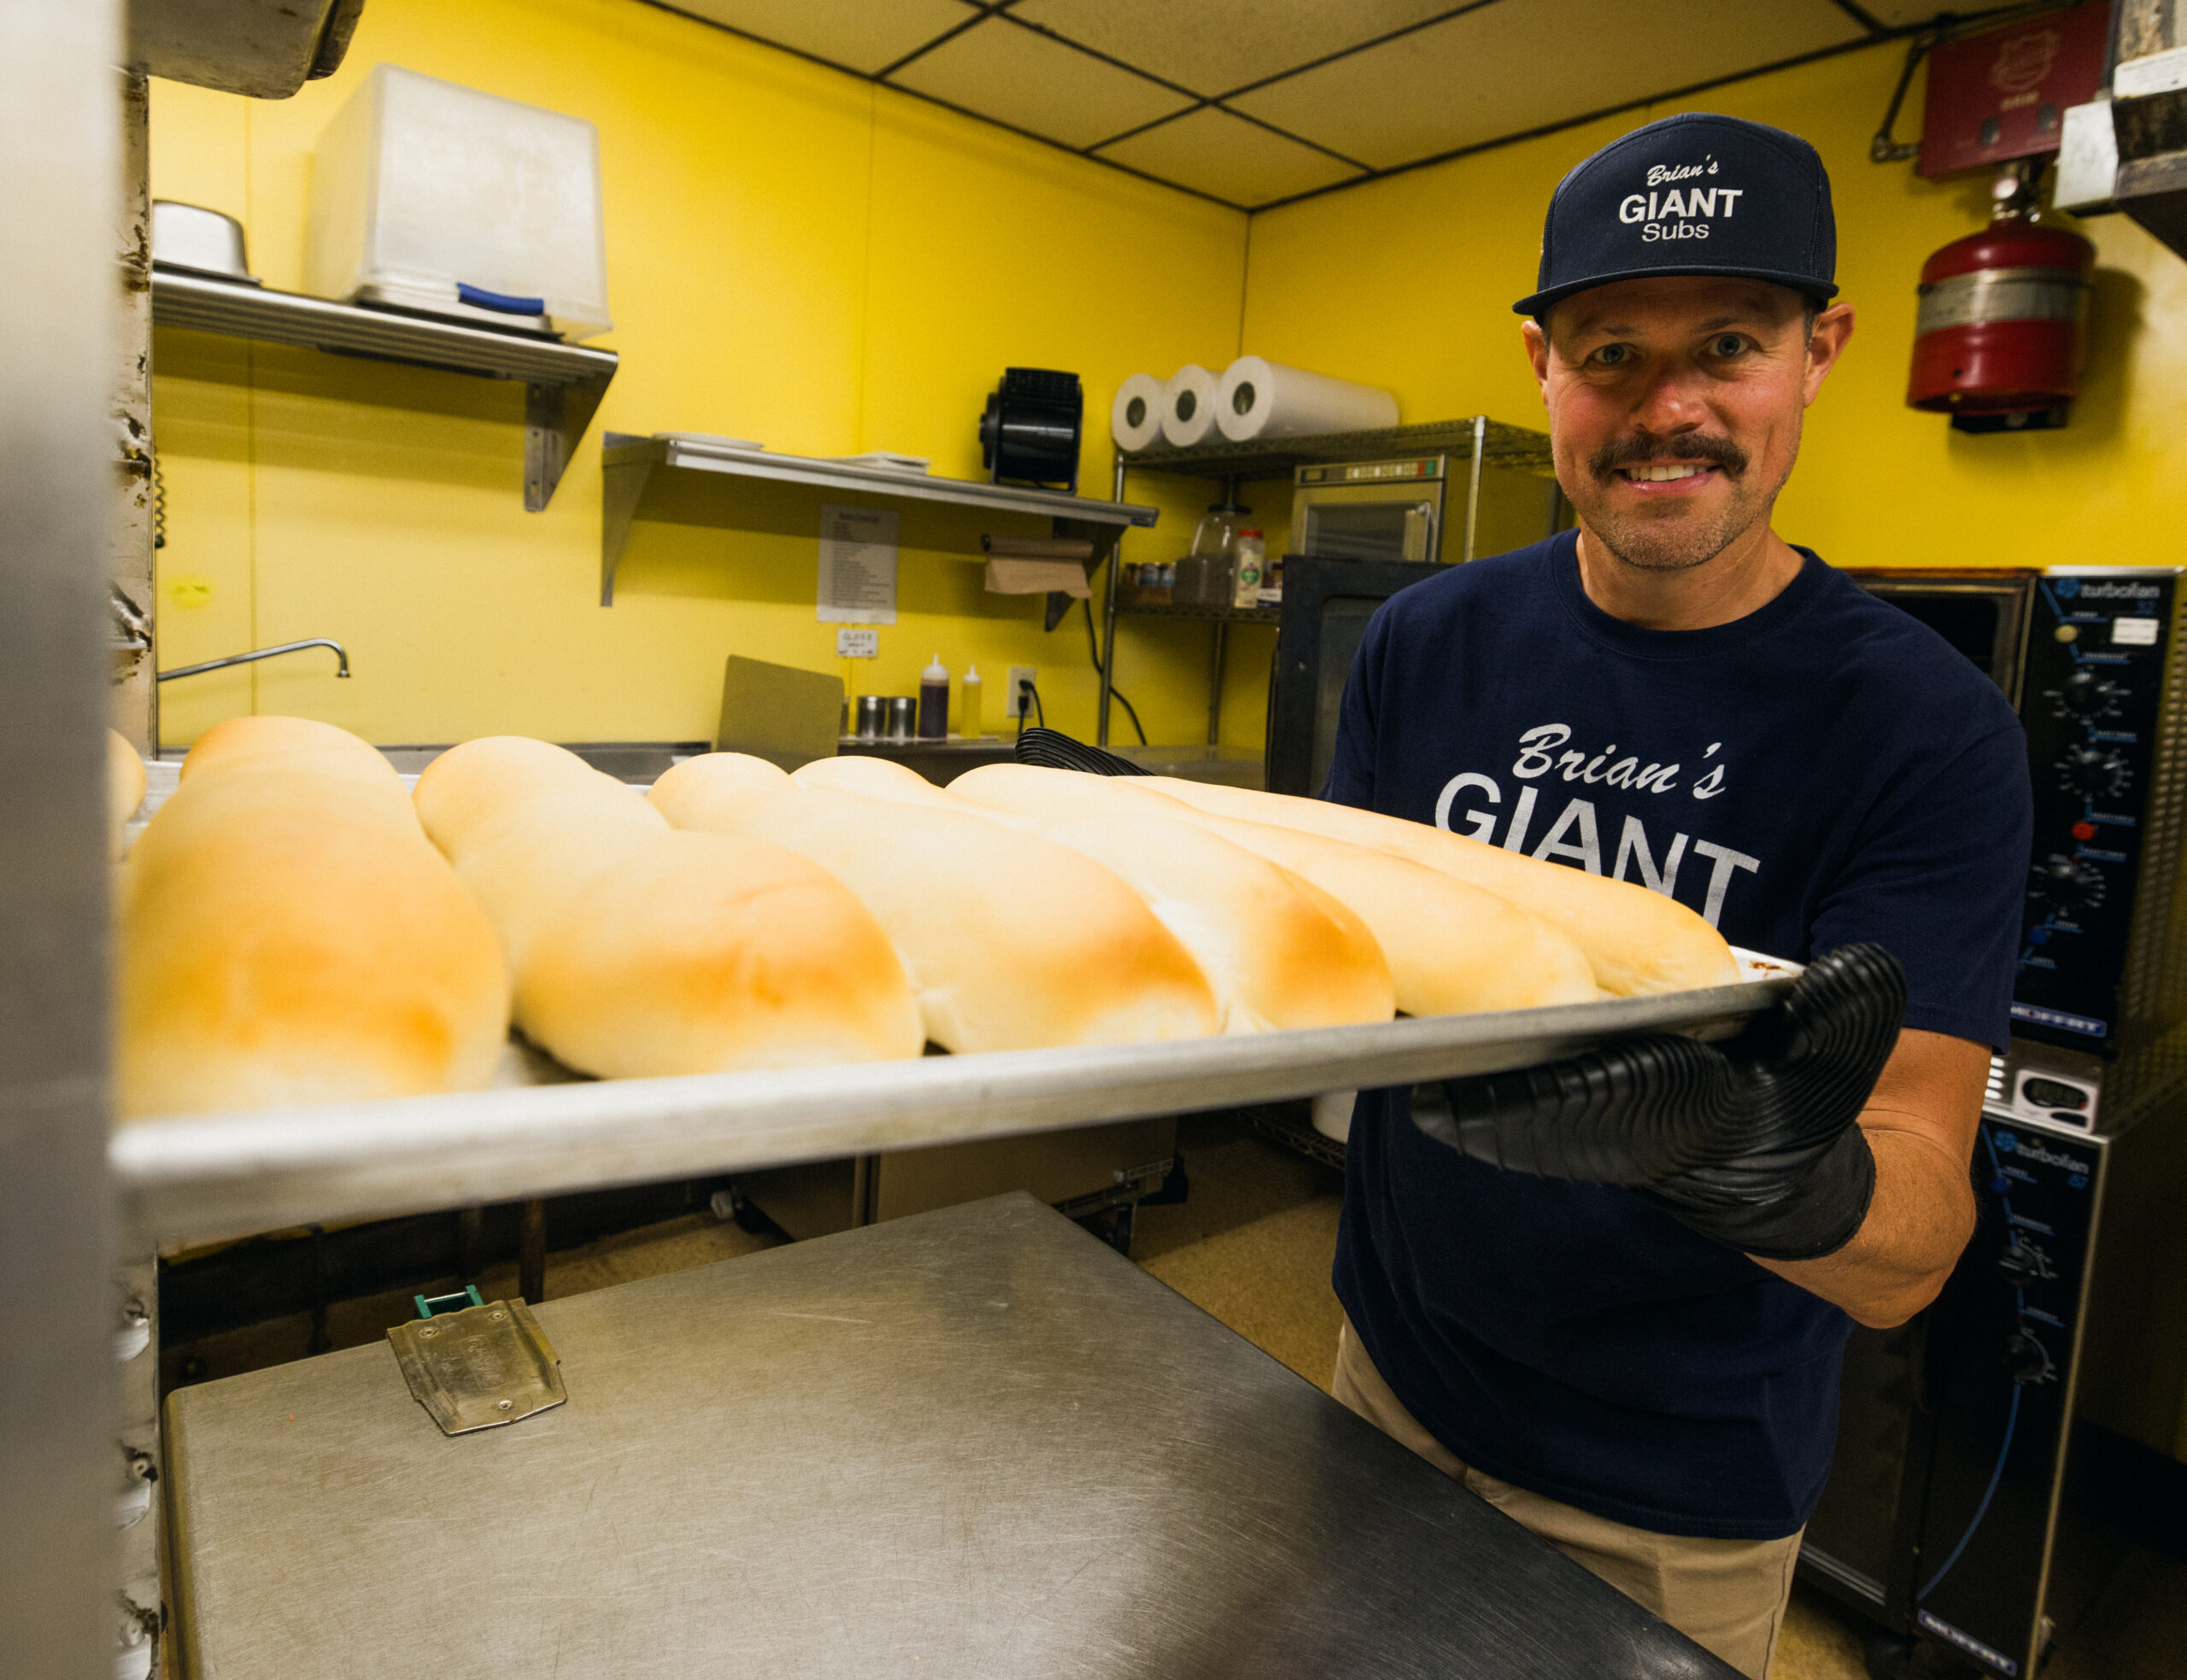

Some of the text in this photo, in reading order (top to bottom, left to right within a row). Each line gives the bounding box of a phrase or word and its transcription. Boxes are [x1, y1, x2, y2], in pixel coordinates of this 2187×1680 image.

[1646, 155, 1720, 187] Brian's
[1618, 188, 1743, 224] GIANT
[1641, 220, 1709, 243] Subs
[2081, 581, 2161, 599] turbofan
[1512, 723, 1726, 799] Brian's
[1434, 771, 1761, 931] GIANT
[2016, 1142, 2090, 1174] turbofan
